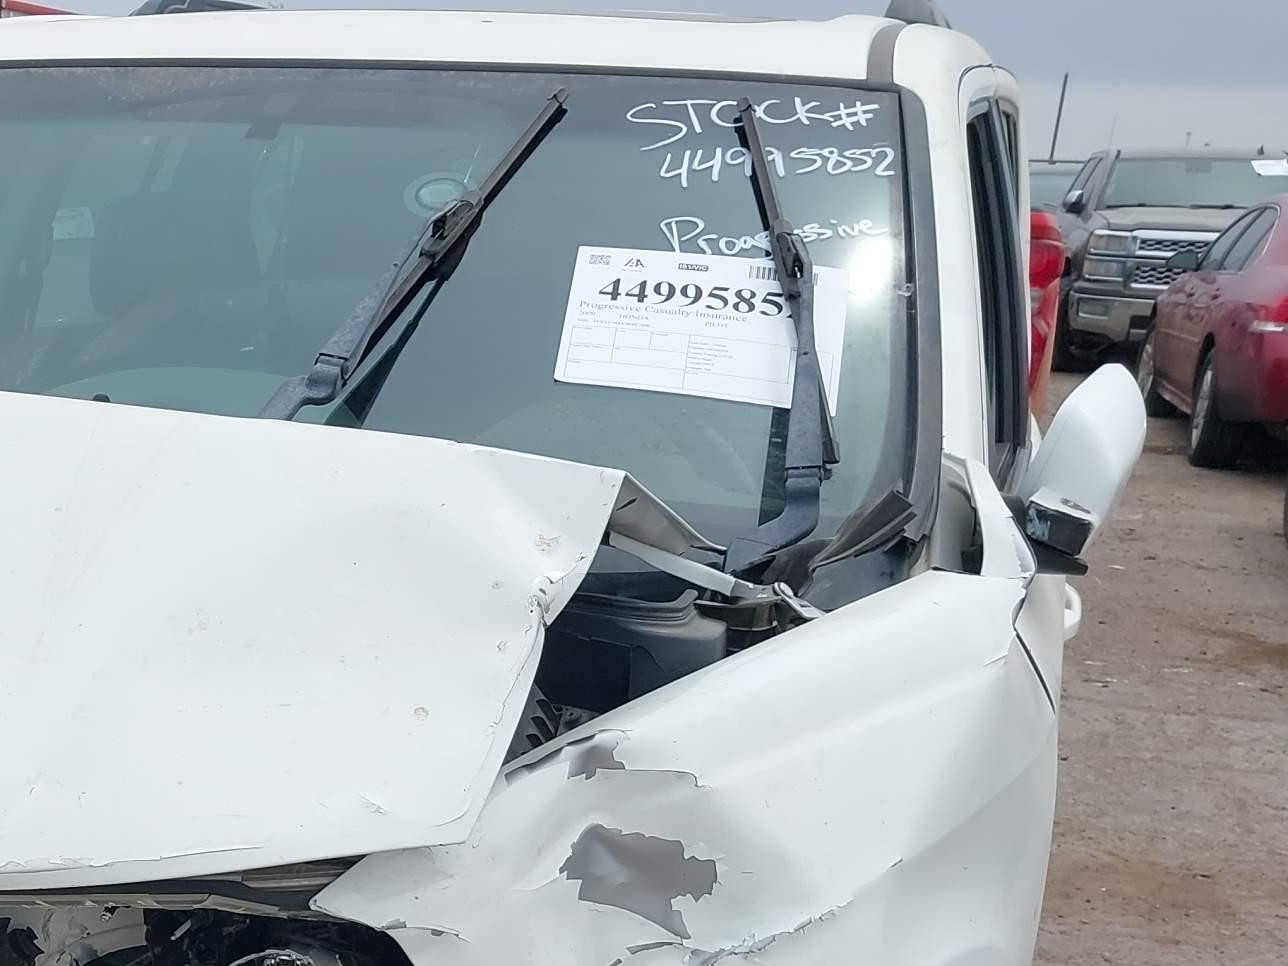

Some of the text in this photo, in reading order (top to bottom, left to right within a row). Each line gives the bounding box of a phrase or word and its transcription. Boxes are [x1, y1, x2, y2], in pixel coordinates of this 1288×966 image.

[660, 146, 896, 188] 44995852
[579, 300, 748, 322] Progressive Casualty Insurance
[598, 277, 793, 319] 4499585
